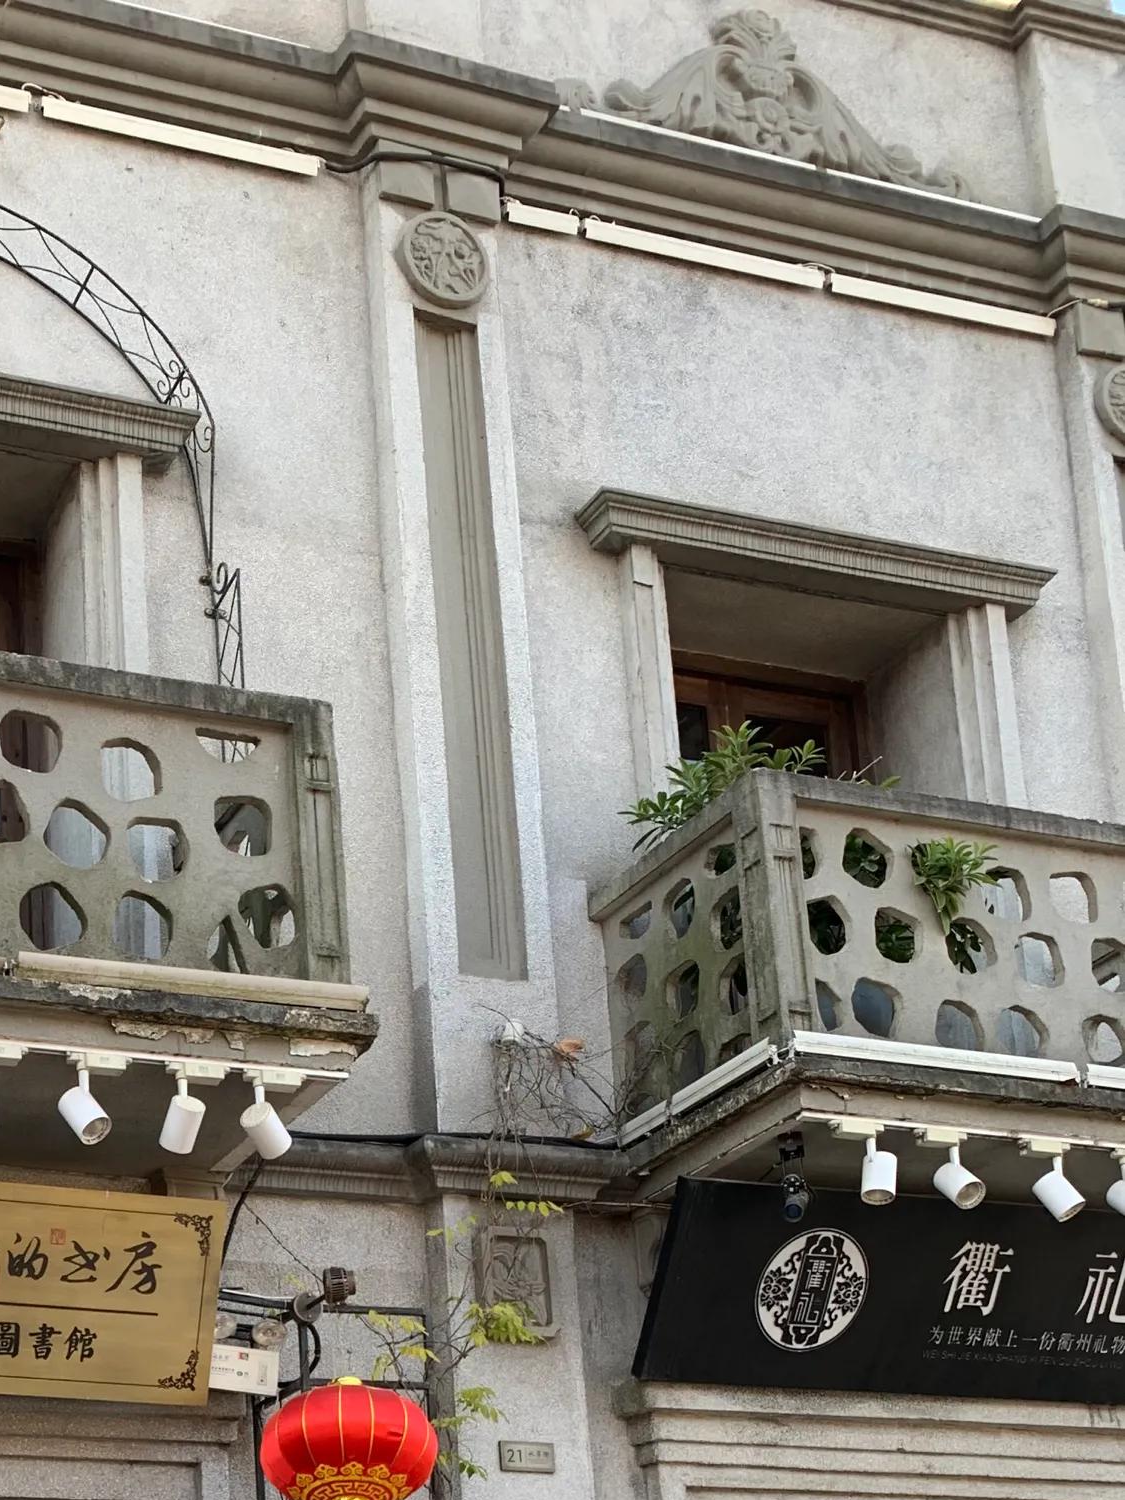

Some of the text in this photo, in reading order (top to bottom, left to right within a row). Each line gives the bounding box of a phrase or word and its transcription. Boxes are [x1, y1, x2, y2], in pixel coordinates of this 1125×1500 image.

[928, 1324, 1125, 1355] 为世界献上一份衢州礼物
[506, 1448, 523, 1463] 21
